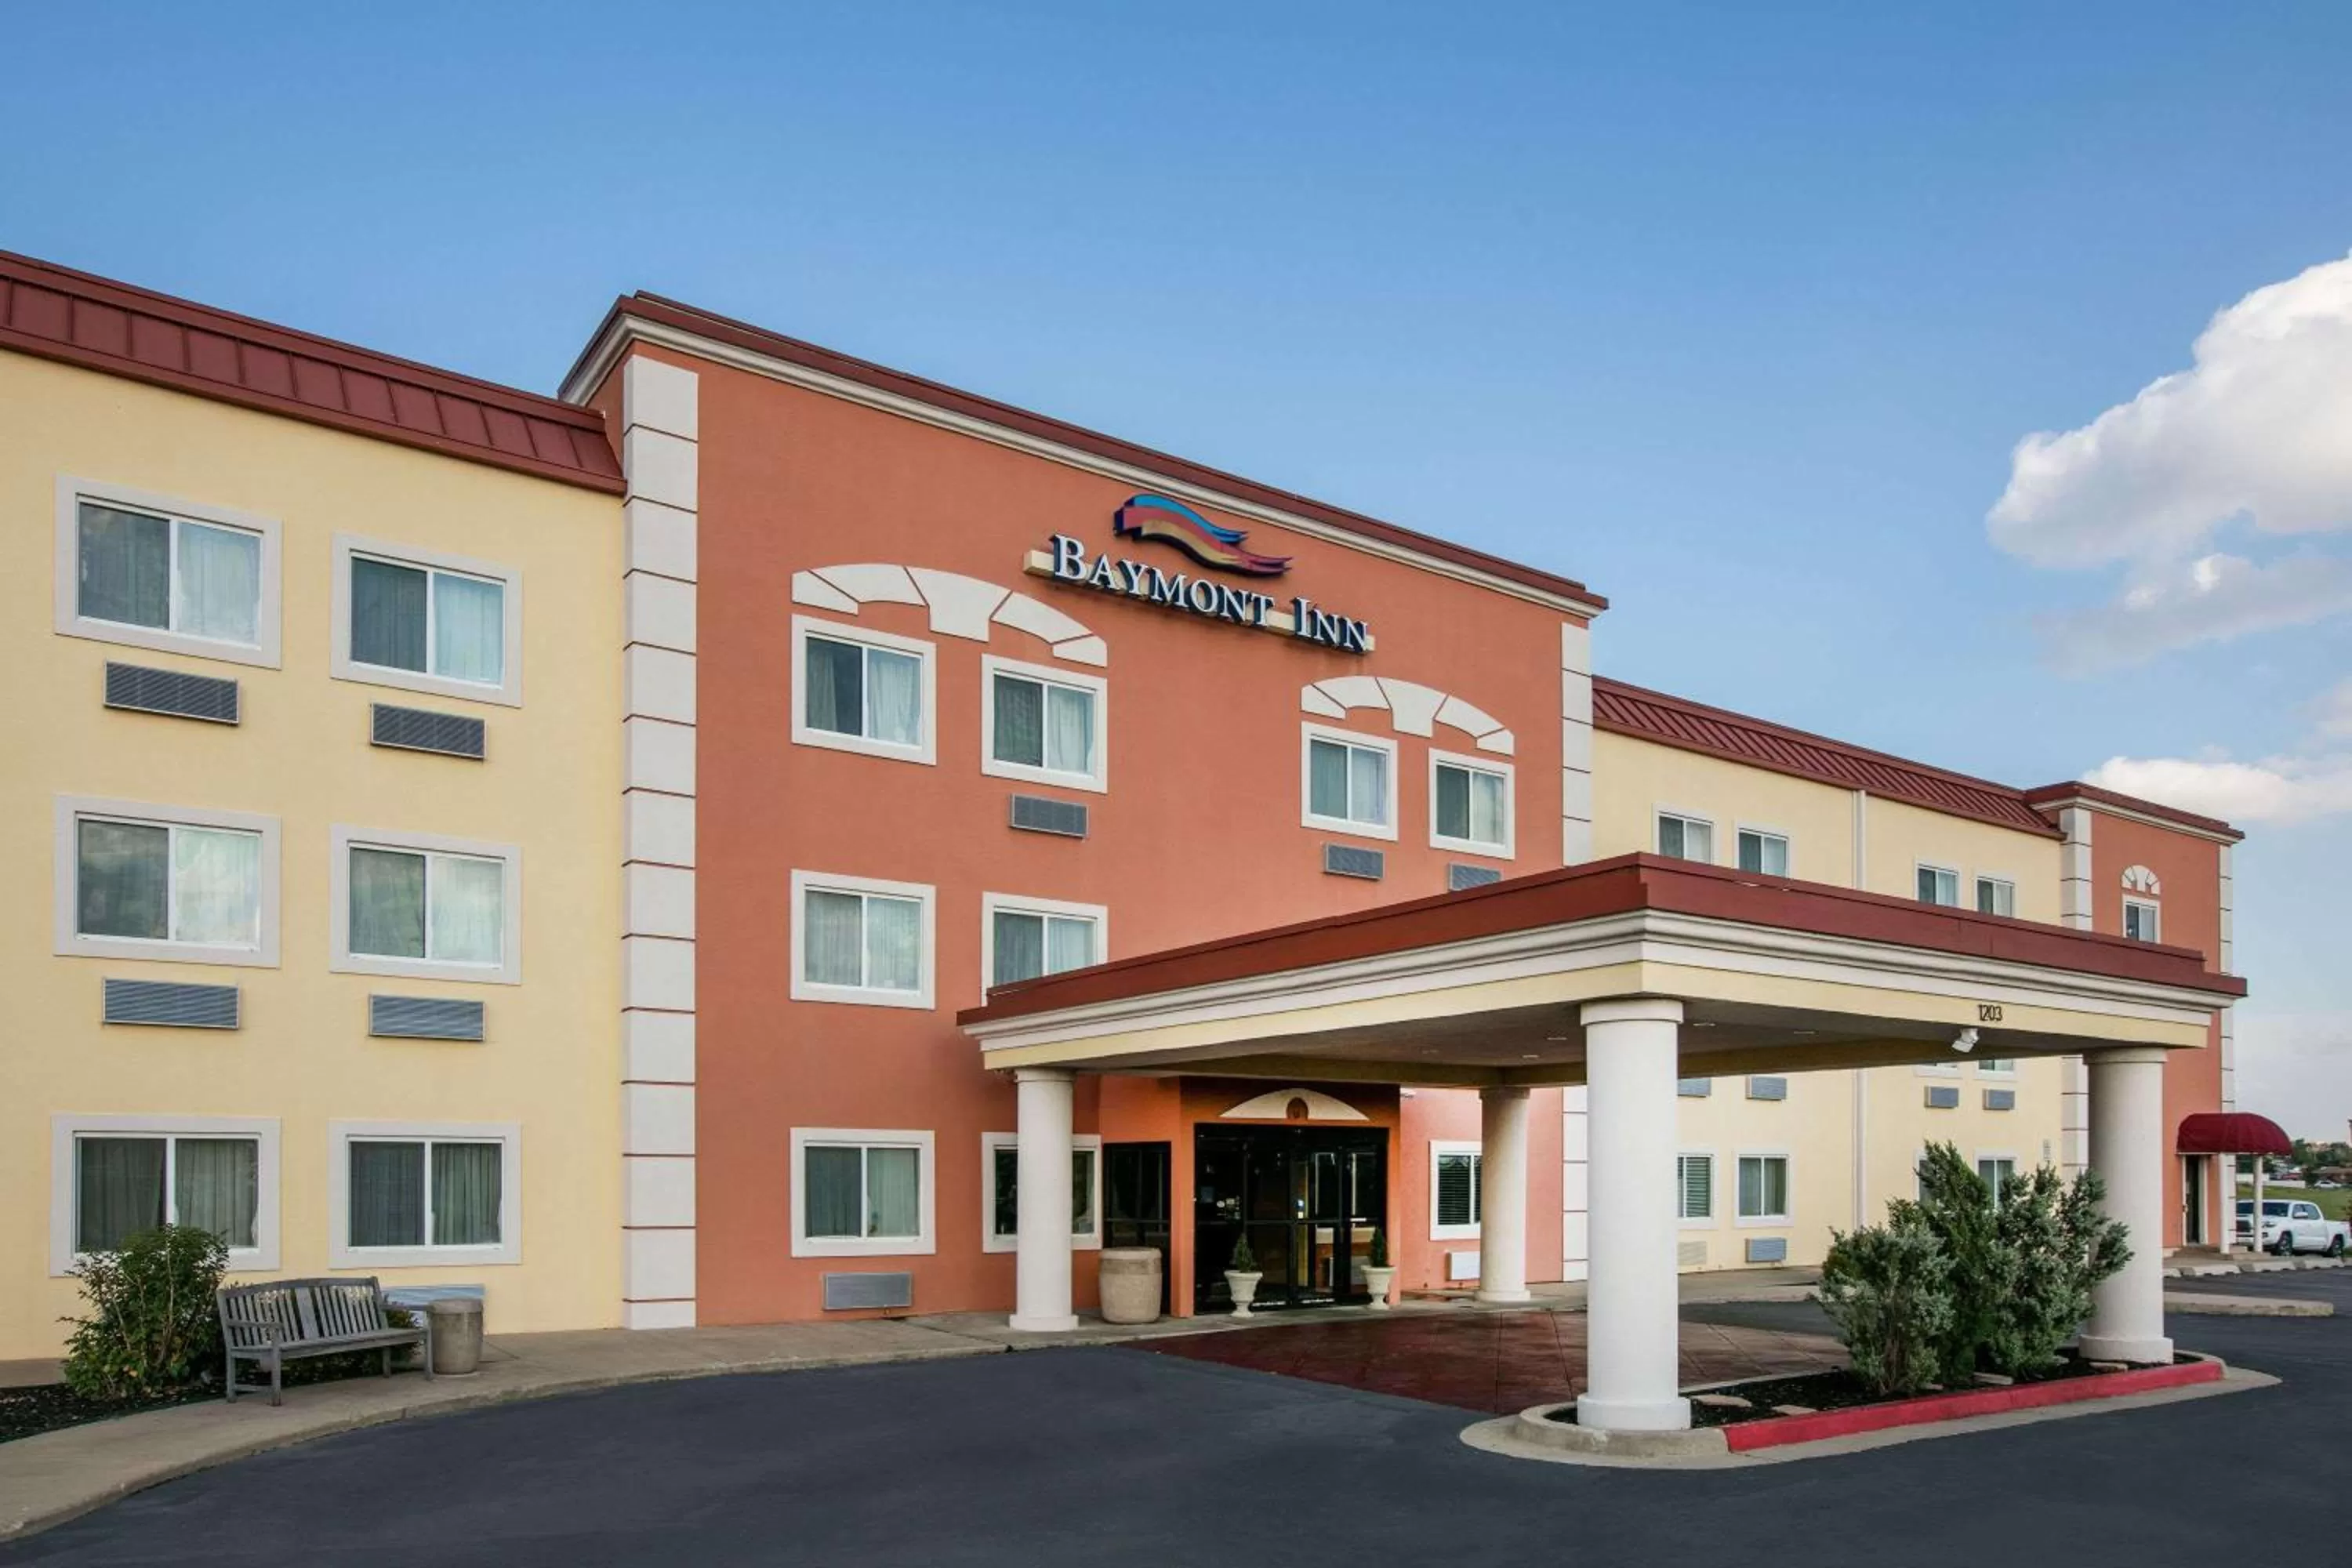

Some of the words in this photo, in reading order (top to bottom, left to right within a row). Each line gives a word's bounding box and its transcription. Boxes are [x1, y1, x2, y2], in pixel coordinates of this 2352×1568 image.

[1051, 533, 1276, 627] BAYMONT
[1294, 597, 1369, 652] INN
[1978, 1004, 2003, 1022] 1203
